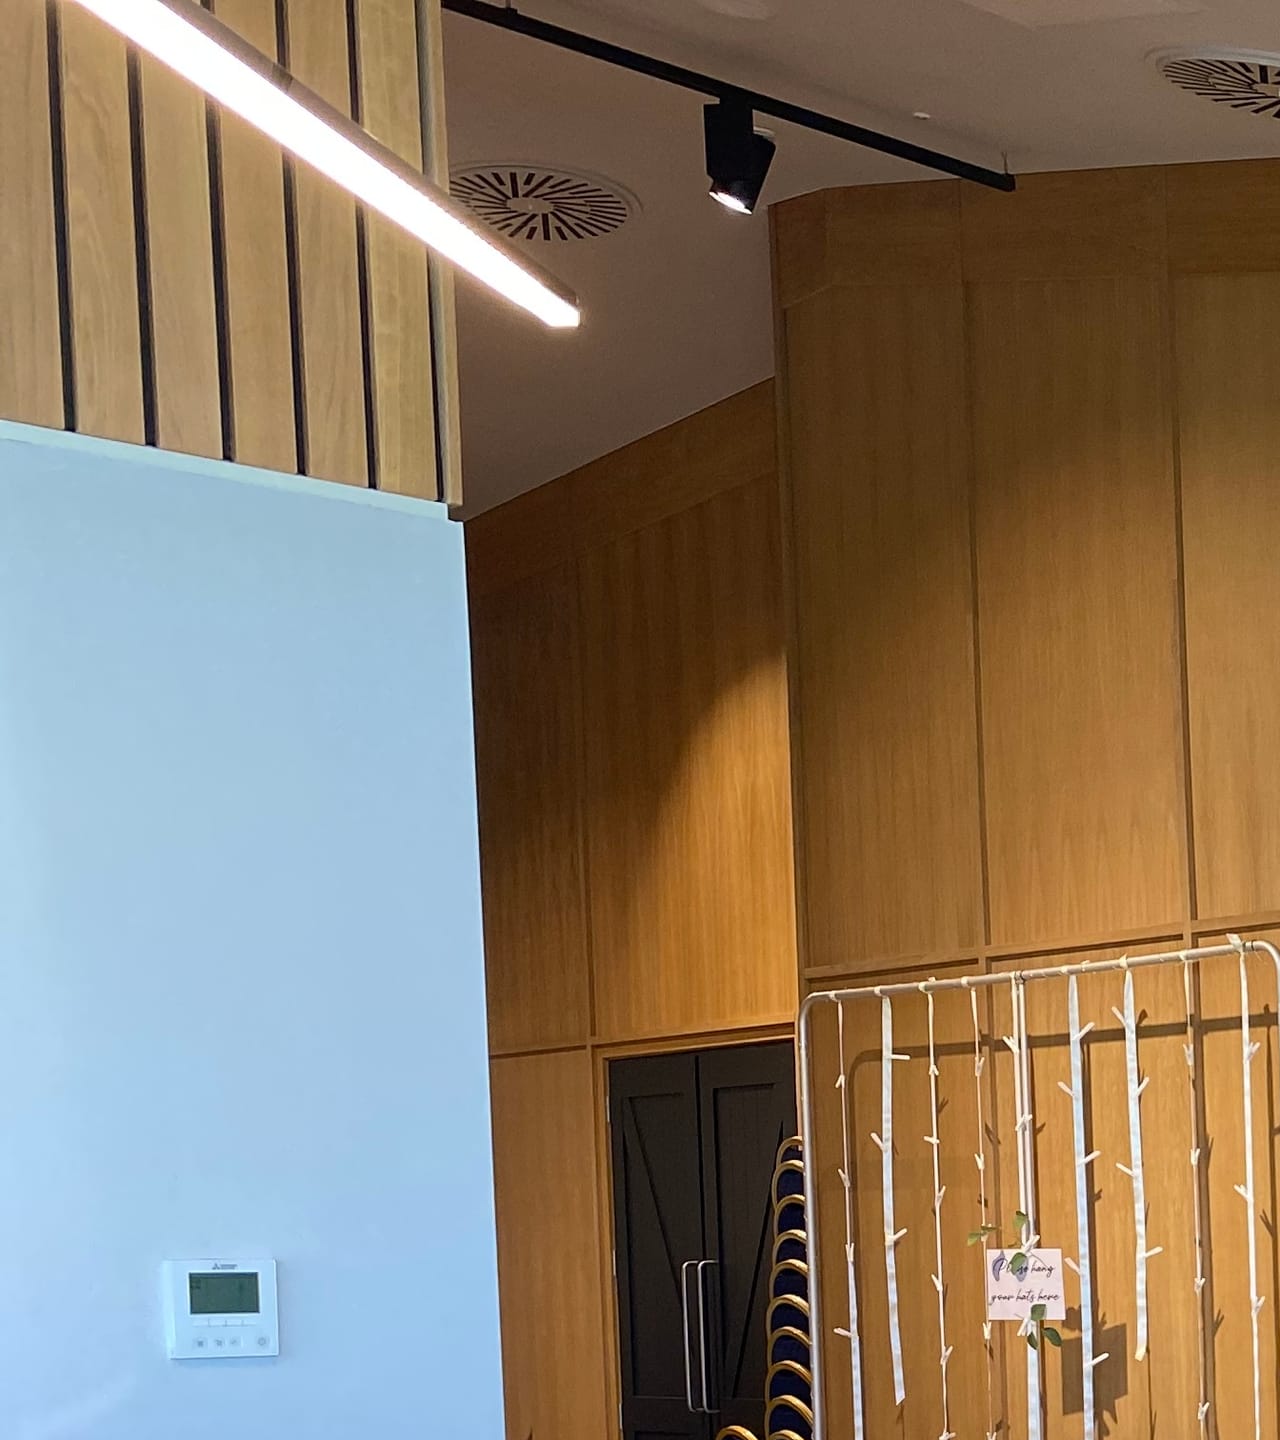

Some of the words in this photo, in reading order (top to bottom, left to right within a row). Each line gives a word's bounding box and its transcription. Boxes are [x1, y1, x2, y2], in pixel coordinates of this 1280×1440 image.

[992, 1257, 1029, 1276] Plse
[1031, 1260, 1055, 1278] hang
[988, 1294, 1014, 1306] your
[1016, 1288, 1035, 1303] hats
[1037, 1288, 1060, 1301] here
